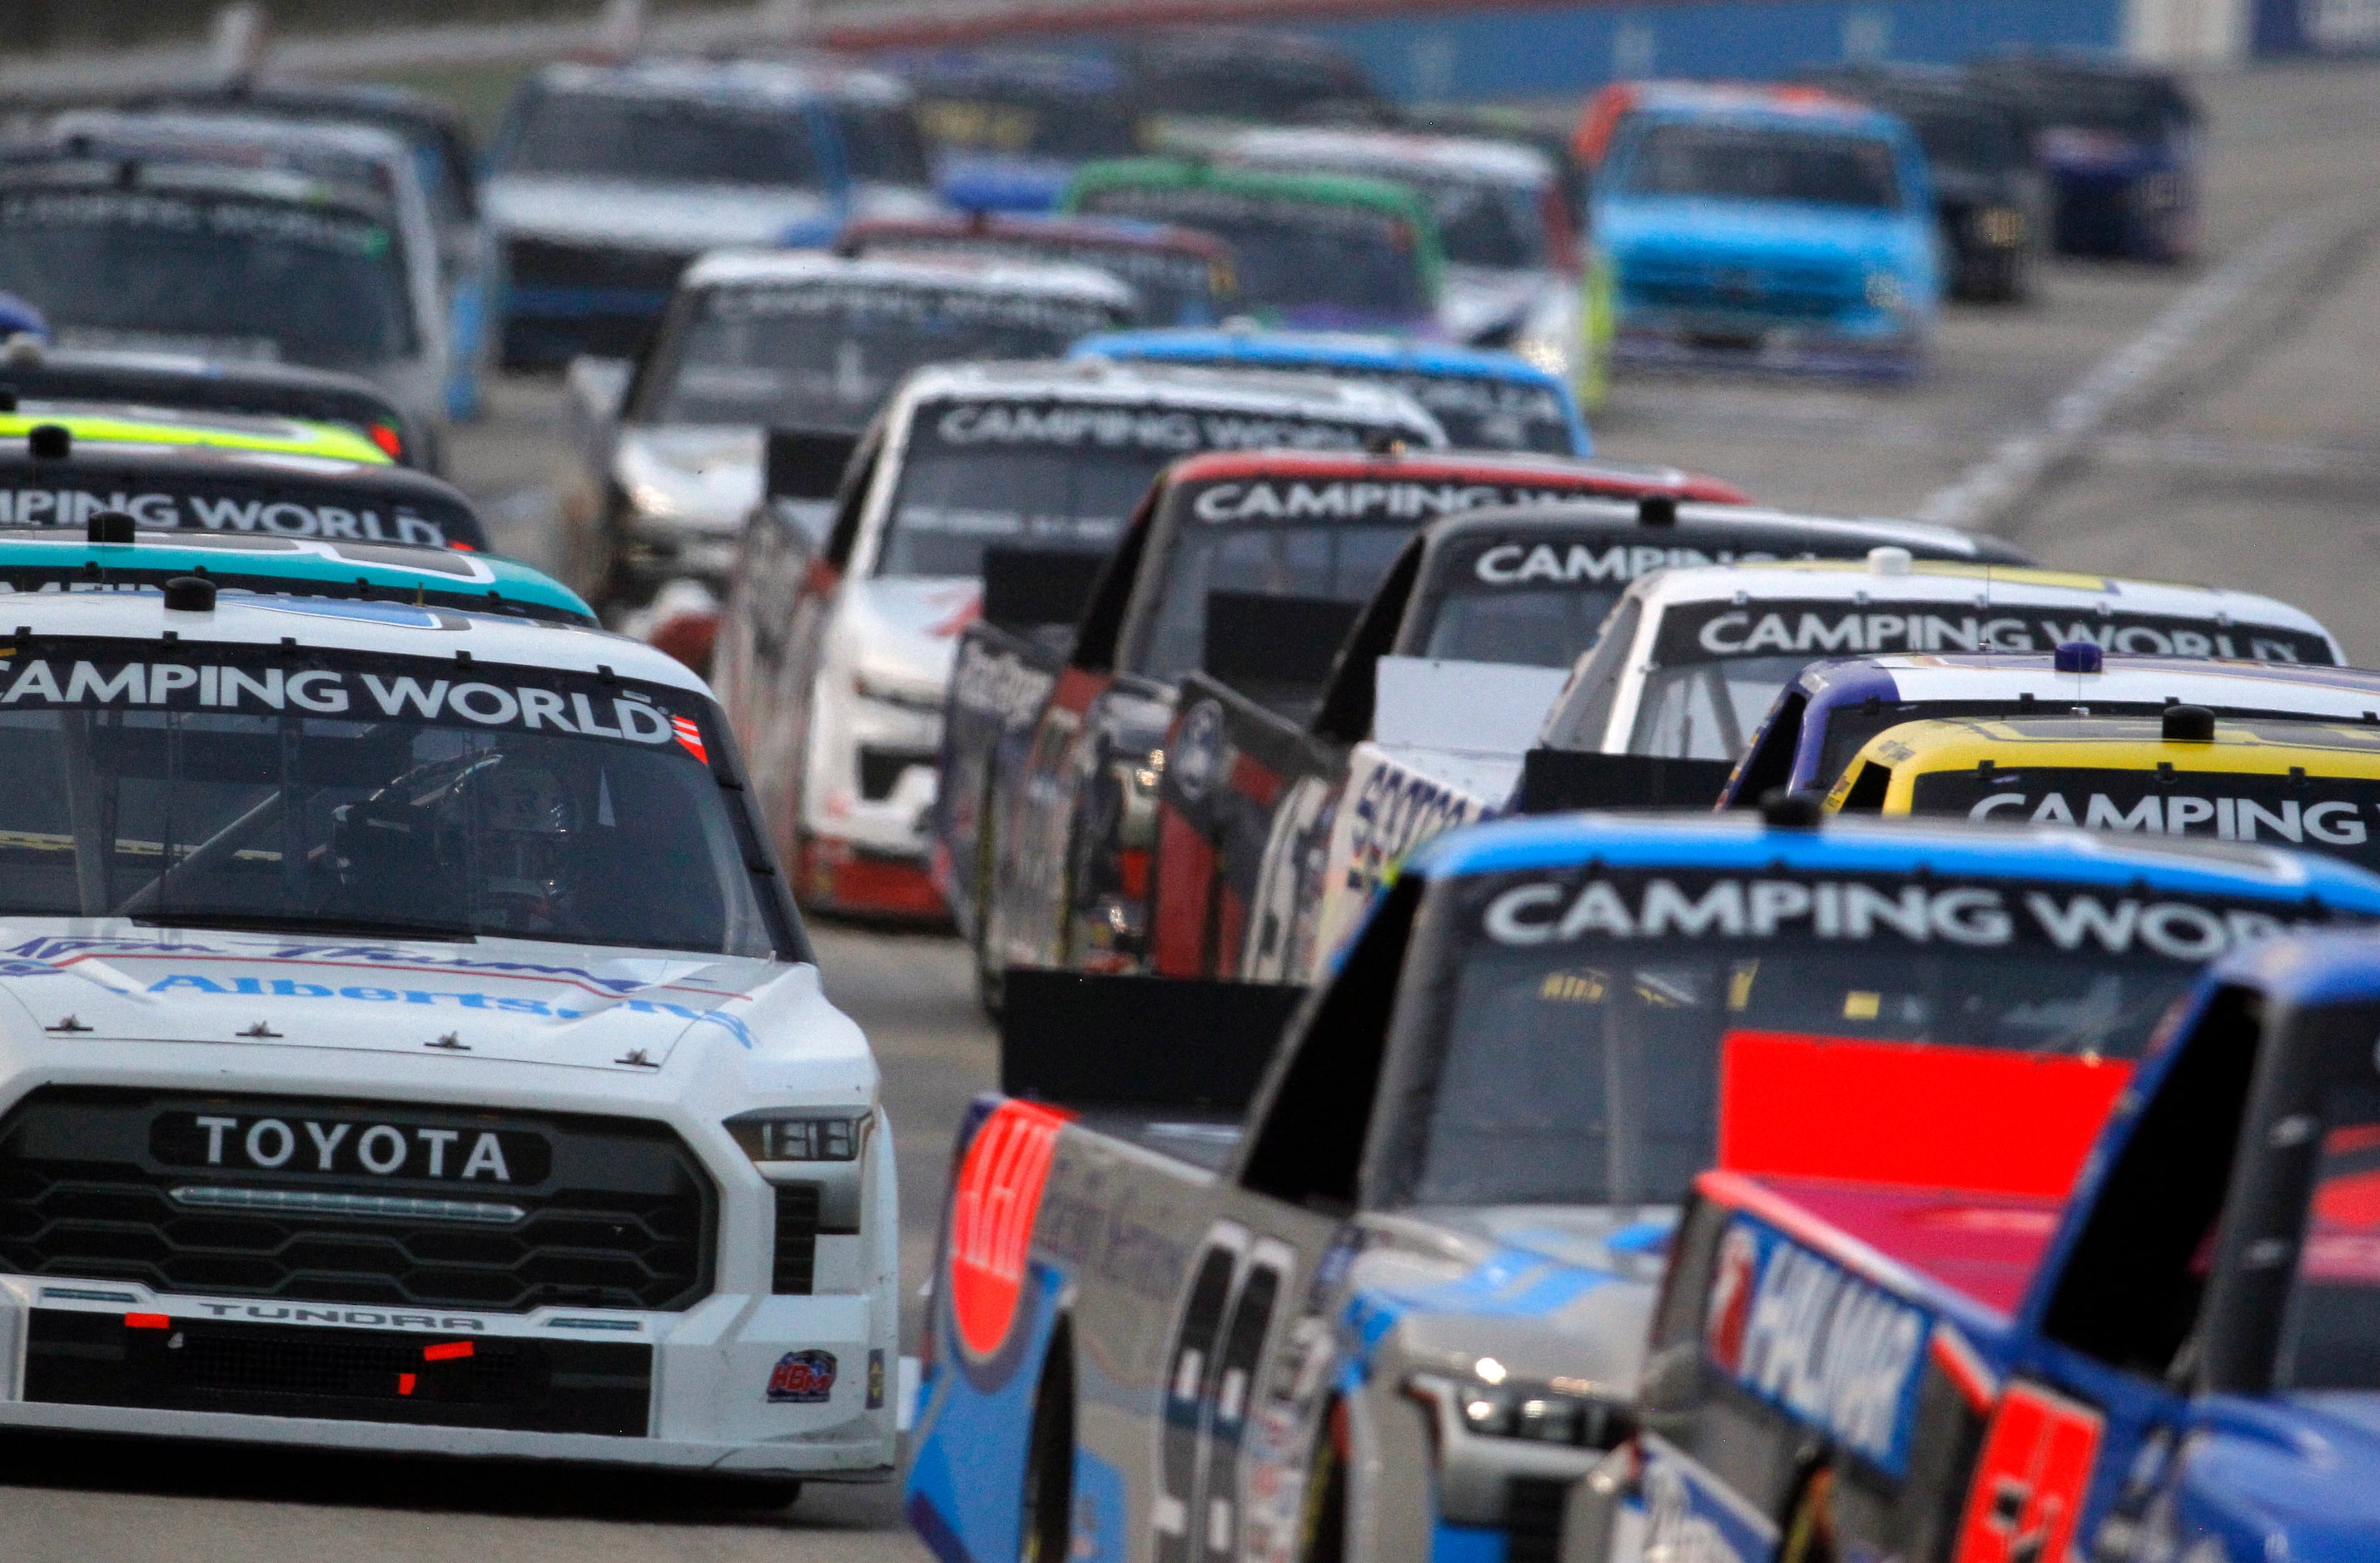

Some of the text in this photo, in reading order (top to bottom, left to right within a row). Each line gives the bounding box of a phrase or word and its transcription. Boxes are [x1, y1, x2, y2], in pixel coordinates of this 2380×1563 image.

[189, 496, 447, 548] WORLD
[1699, 613, 2034, 654] CAMPING
[0, 659, 673, 744] AMPING WORLD
[1484, 879, 2013, 945] CAMPING
[196, 1115, 511, 1182] TOYOTA
[198, 1302, 485, 1332] TUNDRA
